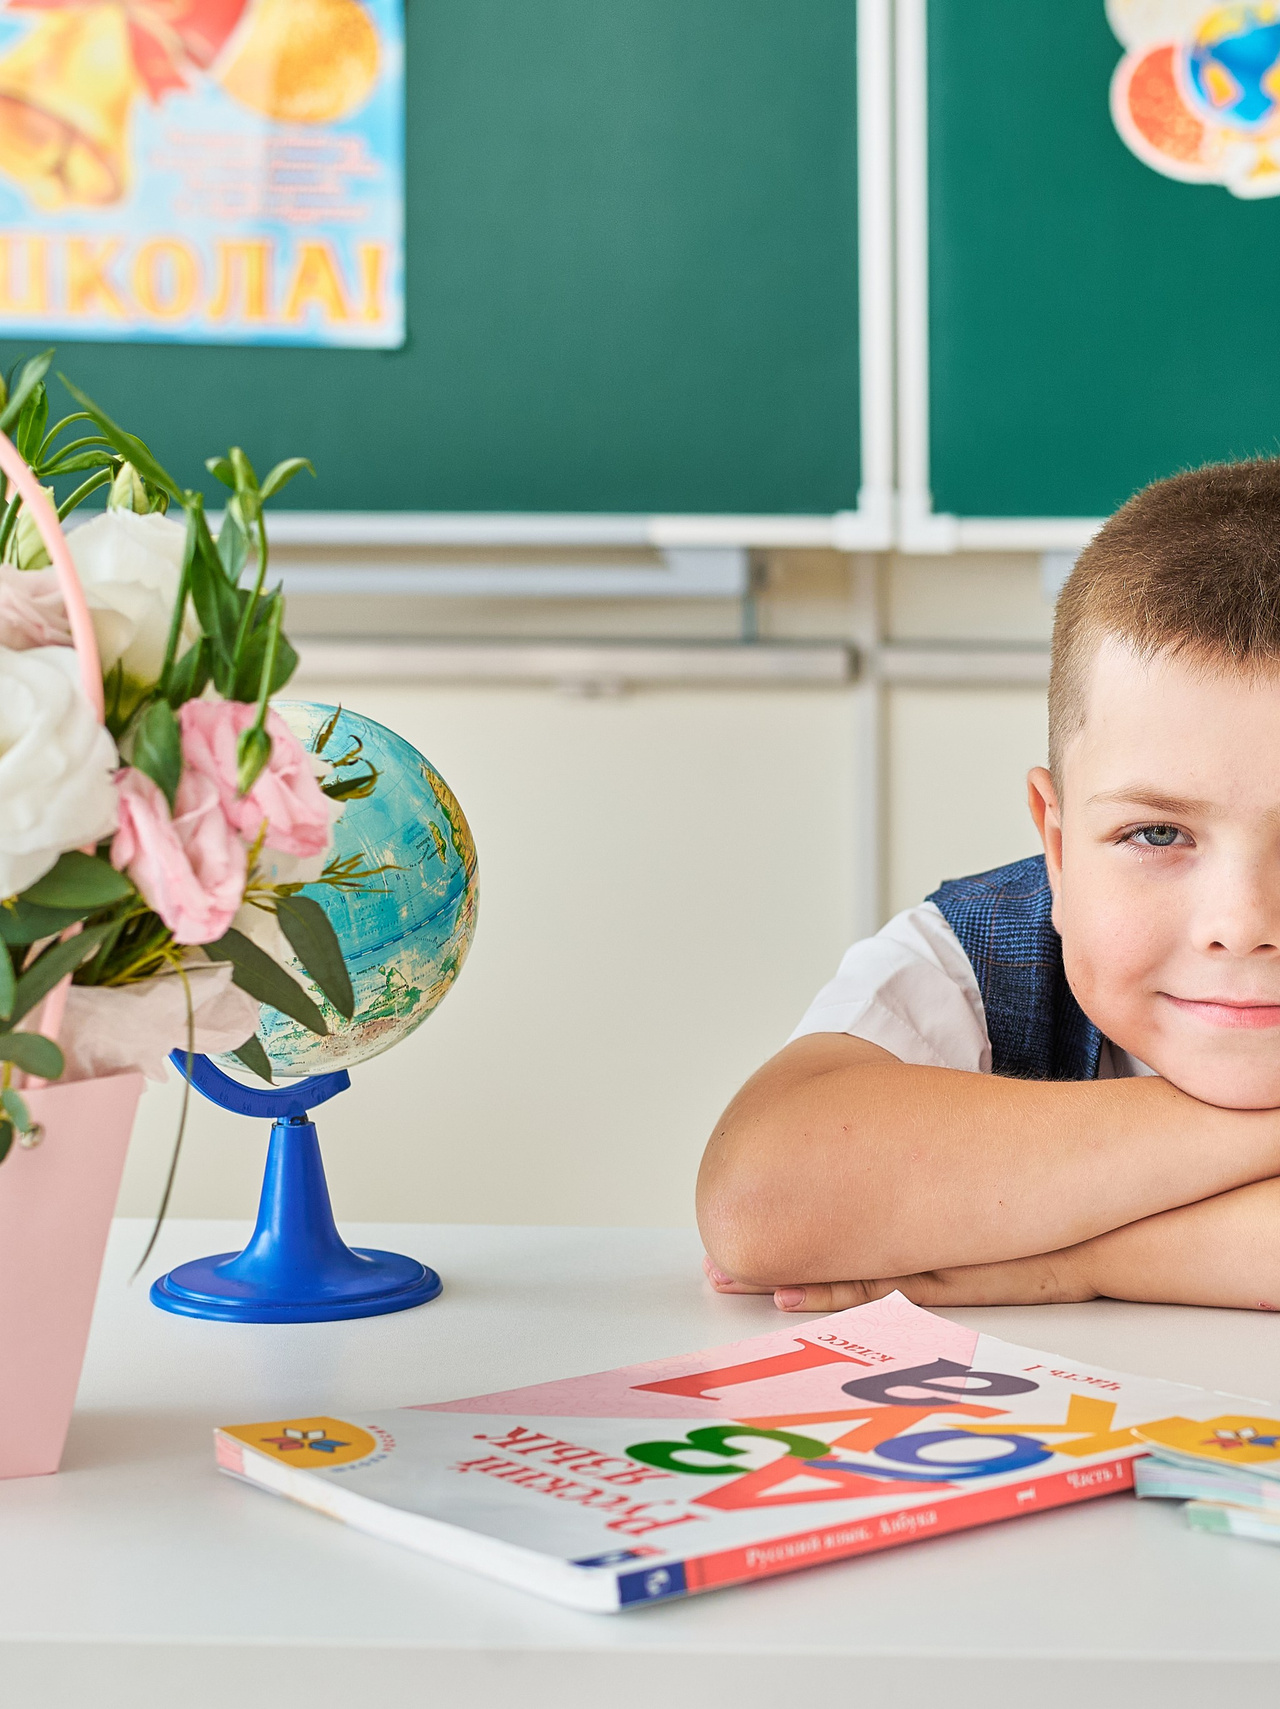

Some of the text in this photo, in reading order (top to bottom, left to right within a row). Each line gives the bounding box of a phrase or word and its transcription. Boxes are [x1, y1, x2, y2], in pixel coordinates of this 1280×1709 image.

[447, 1456, 708, 1536] Русский
[745, 1525, 821, 1569] Русский
[878, 1509, 938, 1535] Азбука
[1066, 1468, 1113, 1489] Часть
